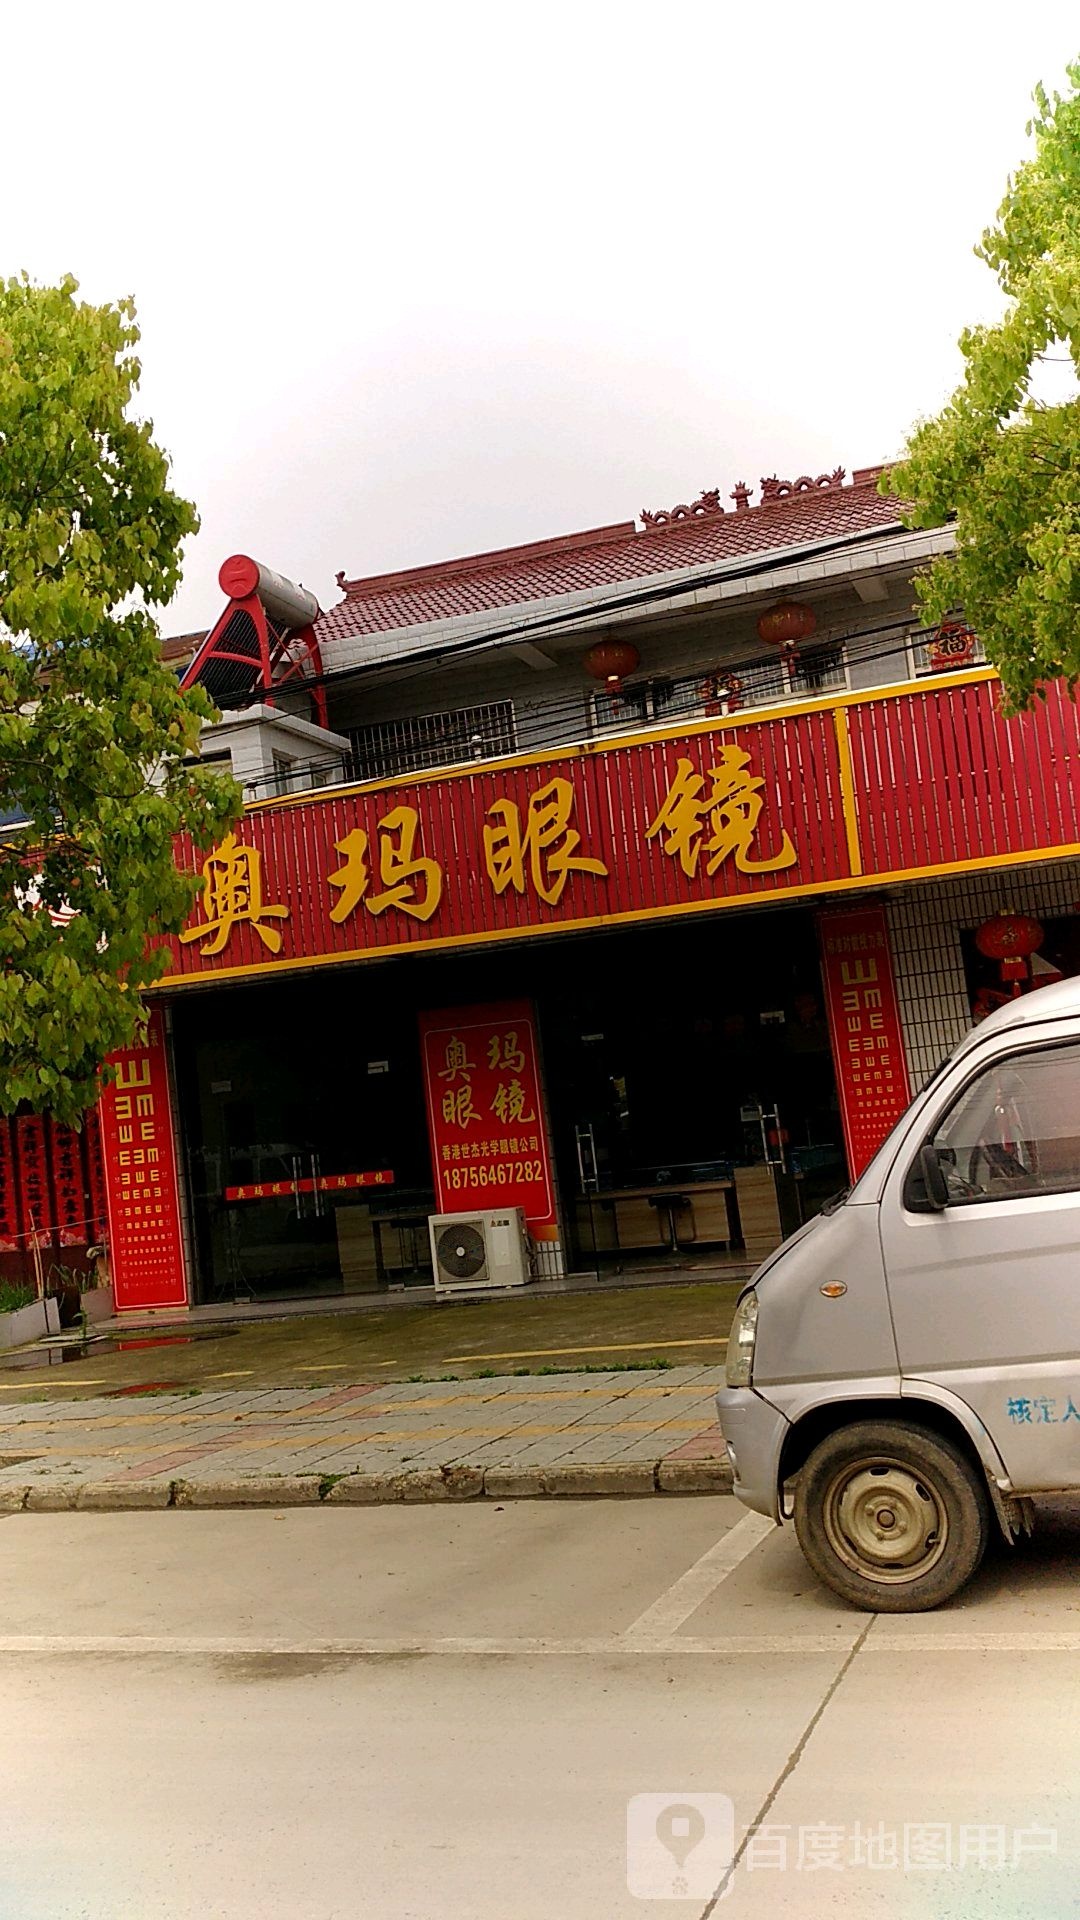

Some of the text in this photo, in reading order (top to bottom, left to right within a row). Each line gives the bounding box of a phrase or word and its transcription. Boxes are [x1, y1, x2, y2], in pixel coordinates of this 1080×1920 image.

[939, 632, 967, 656] 福
[179, 744, 797, 955] 奥玛眼镜
[437, 1031, 526, 1082] 奥玛
[442, 1079, 536, 1129] 眼镜
[441, 1136, 539, 1161] 香港世杰光学眼镜公司
[443, 1160, 543, 1190] 18756467282
